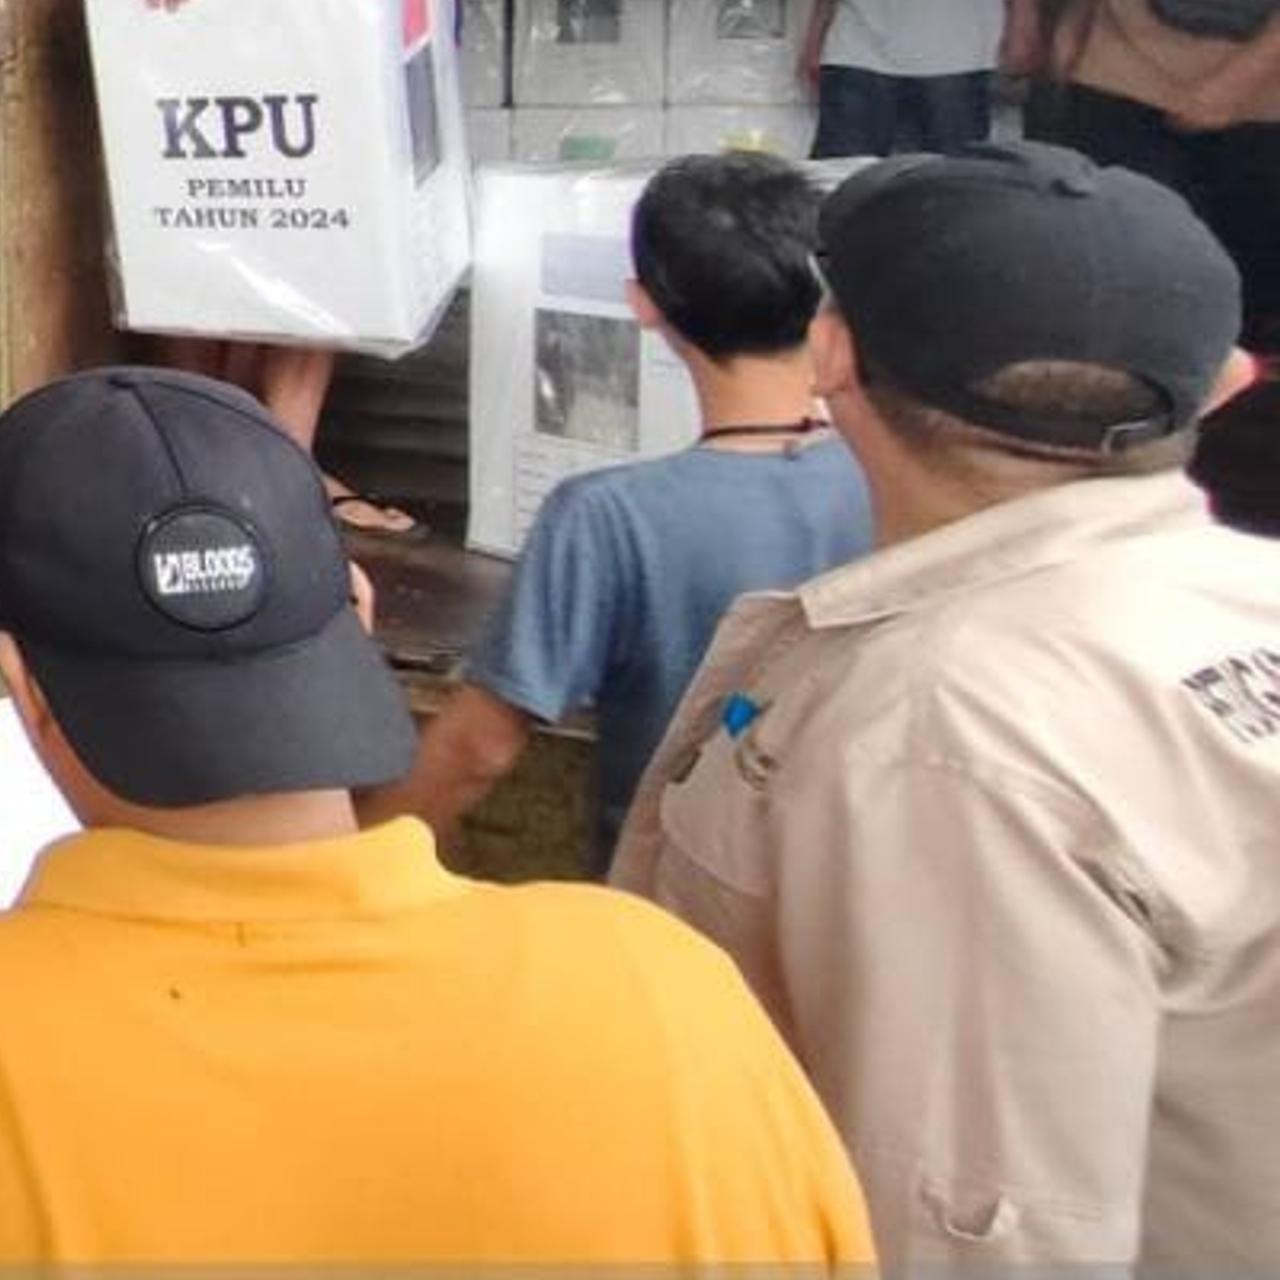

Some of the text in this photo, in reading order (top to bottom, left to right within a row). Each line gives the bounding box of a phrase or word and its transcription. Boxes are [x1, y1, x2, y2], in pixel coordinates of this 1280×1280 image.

[156, 93, 319, 159] KPU
[184, 178, 307, 199] PEMILU
[154, 206, 351, 230] TAHUN 2024
